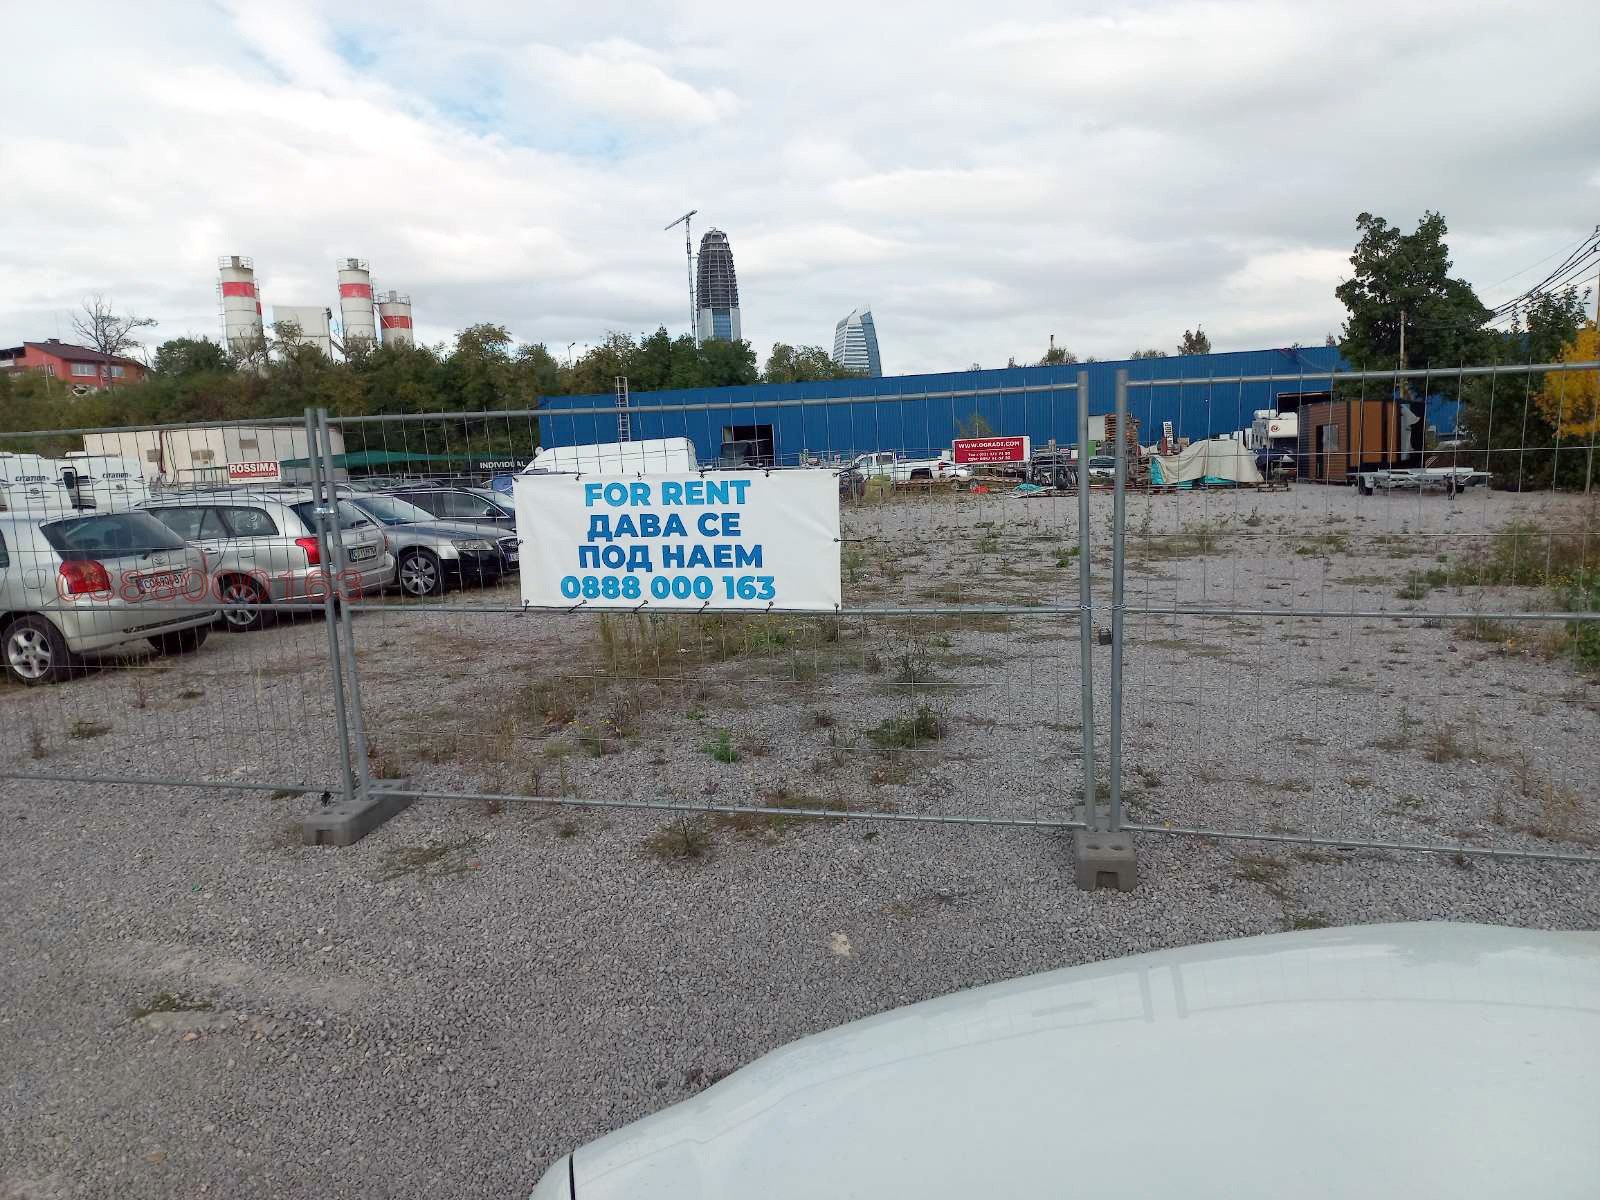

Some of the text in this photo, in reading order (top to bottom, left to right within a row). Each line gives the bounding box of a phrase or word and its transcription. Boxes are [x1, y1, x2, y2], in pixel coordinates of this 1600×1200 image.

[229, 462, 276, 473] ROSSIMA
[584, 480, 752, 507] FOR RENT
[587, 512, 742, 543] ДАВА СЕ
[578, 543, 763, 573] ПОД НАЕМ
[560, 575, 776, 600] 0888 000 163
